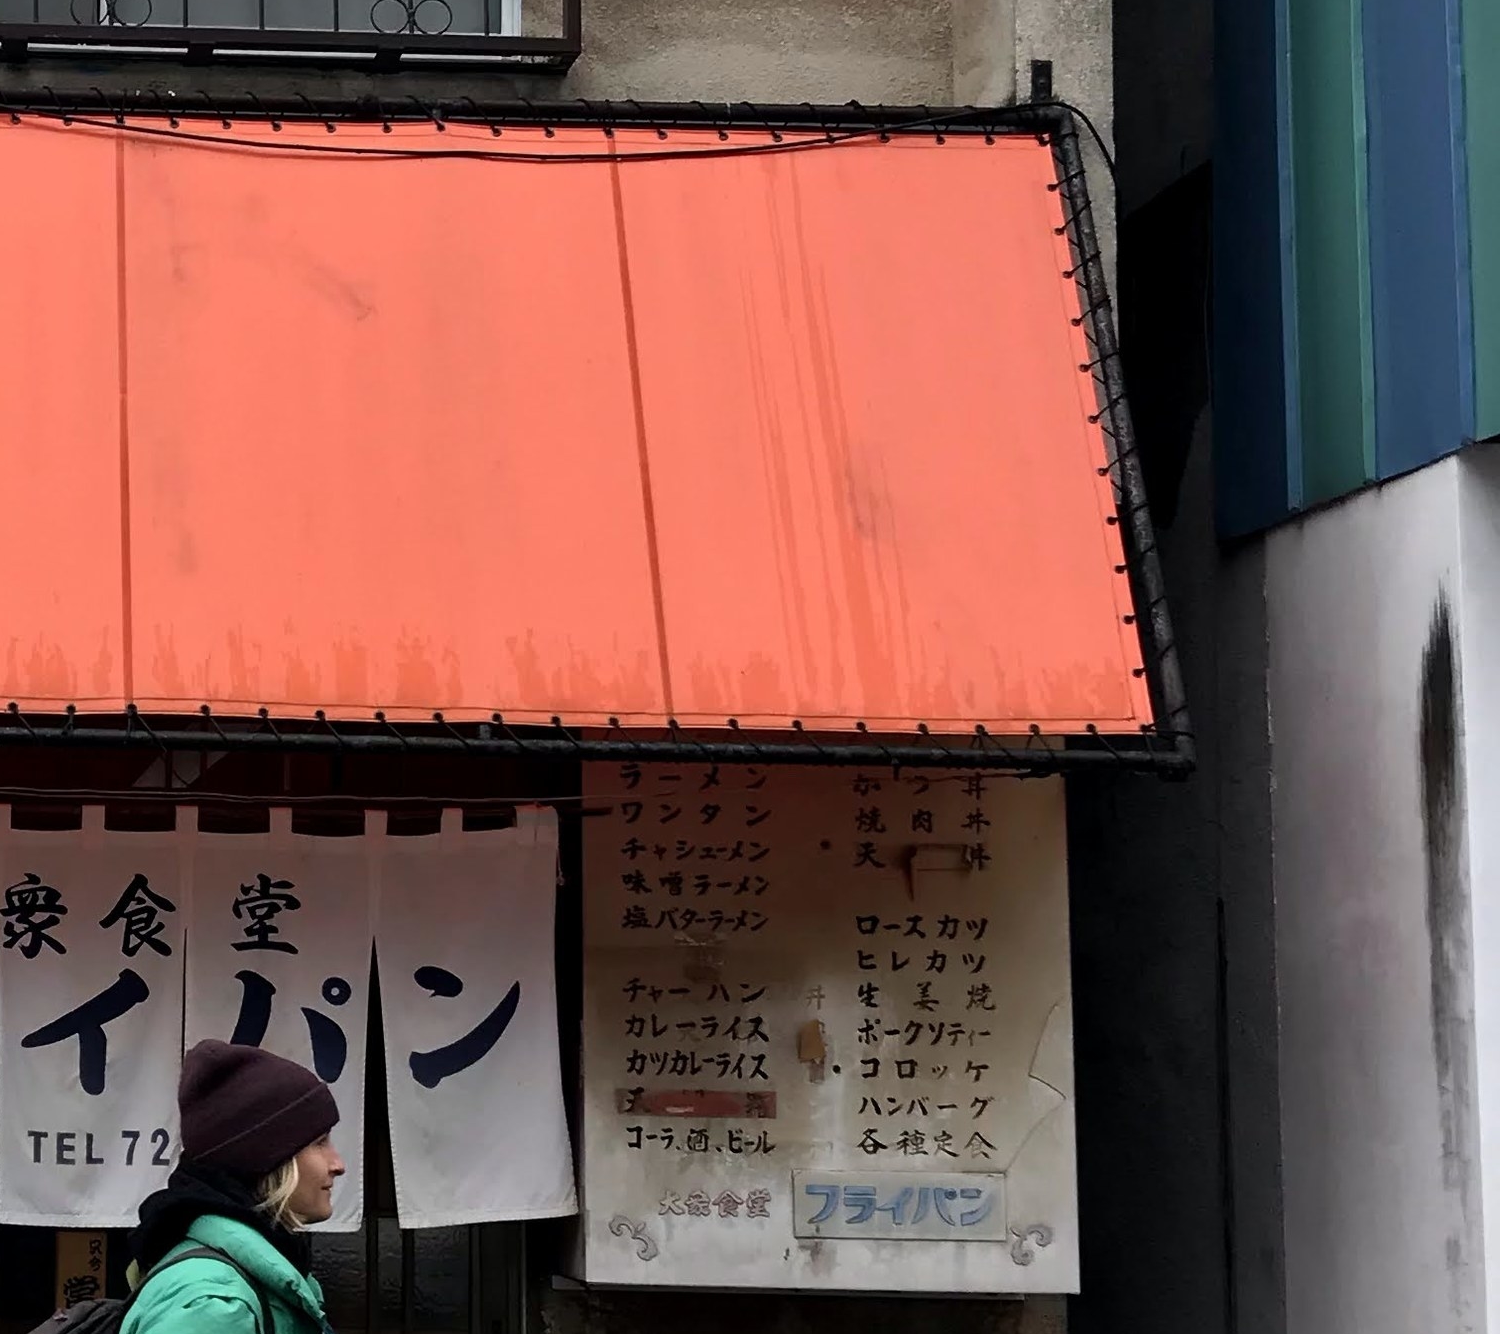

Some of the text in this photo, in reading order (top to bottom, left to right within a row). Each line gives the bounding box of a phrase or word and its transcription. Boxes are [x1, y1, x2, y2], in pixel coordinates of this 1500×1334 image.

[620, 764, 768, 791] ラーメン
[621, 803, 772, 827] ワンタン
[855, 807, 991, 835] 焼肉丼
[621, 871, 771, 898] 味噌ラーメン
[620, 905, 769, 931] 塩バターラーメン
[856, 915, 988, 940] ロースカツ
[856, 950, 986, 974] ヒレカツ
[621, 979, 767, 1004] チャーハン
[857, 982, 997, 1012] 生姜焼
[624, 1014, 770, 1043] カレーライス
[626, 1049, 770, 1080] カツカレーライス
[861, 1058, 990, 1083] コロッケ
[858, 1096, 994, 1122] ハンバーグ
[27, 1130, 104, 1166] TEL
[856, 1128, 999, 1160] 各種定食
[658, 1188, 772, 1220] 大衆食堂
[805, 1184, 996, 1227] フライパン
